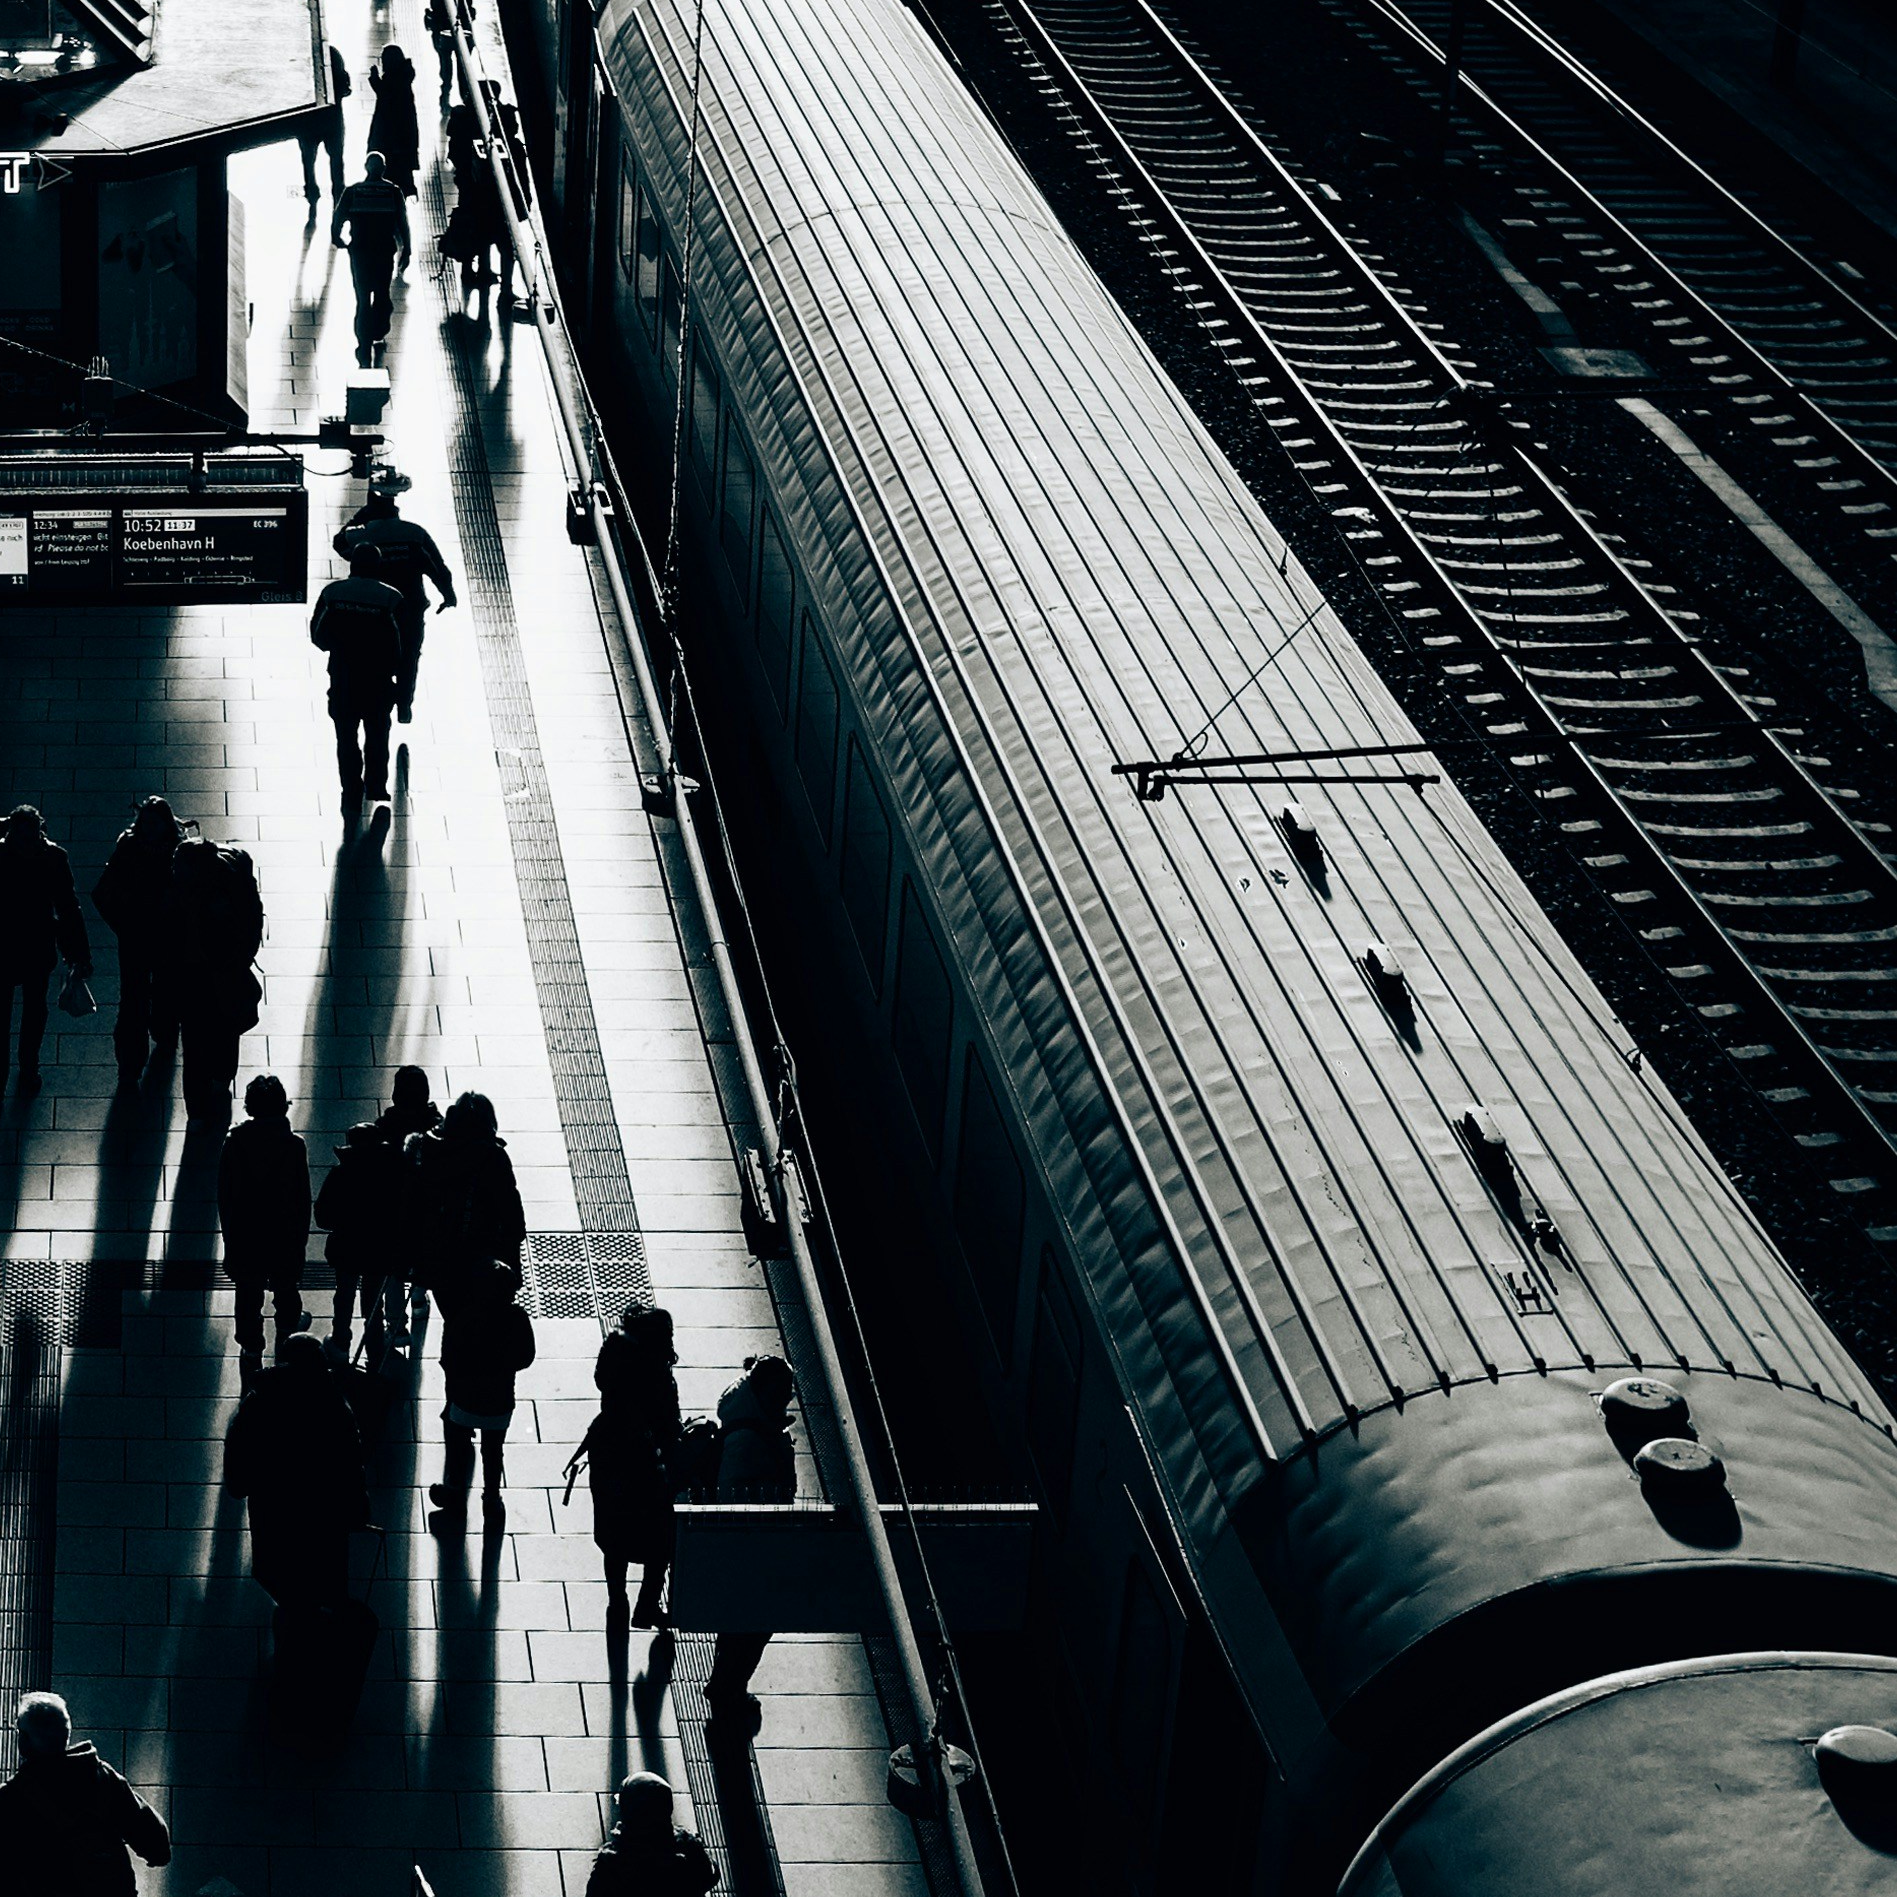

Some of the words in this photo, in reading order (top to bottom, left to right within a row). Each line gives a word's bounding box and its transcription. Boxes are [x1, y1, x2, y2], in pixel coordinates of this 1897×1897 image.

[124, 519, 162, 532] 10:52
[123, 536, 202, 551] Koebenhavn
[205, 536, 215, 549] H
[11, 576, 24, 585] 11
